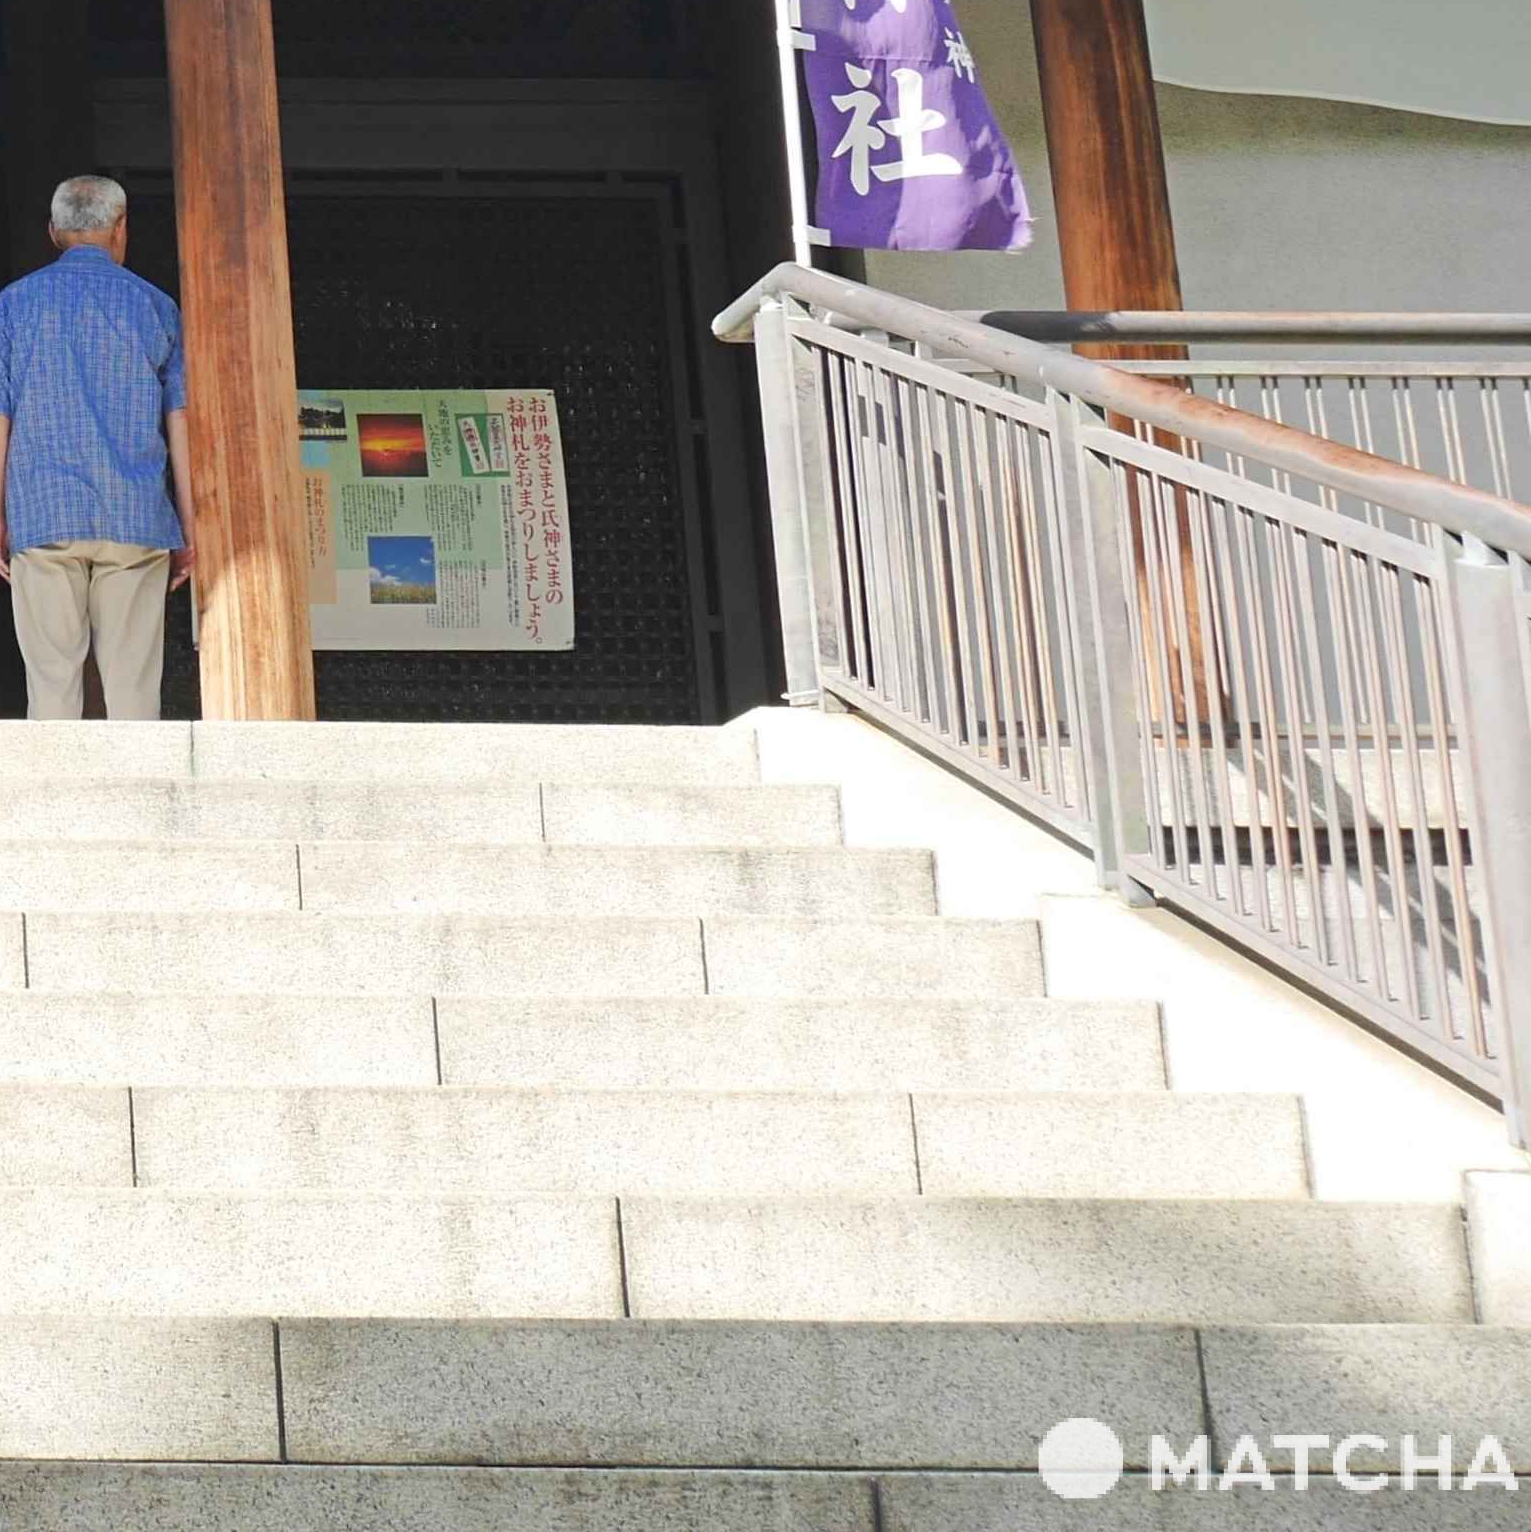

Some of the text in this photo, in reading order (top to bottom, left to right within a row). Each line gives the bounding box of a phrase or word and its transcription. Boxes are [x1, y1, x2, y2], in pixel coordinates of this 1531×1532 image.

[506, 396, 543, 645] お神札をおまつりしましょう。
[528, 396, 564, 605] お伊勢さまと氏神さまの
